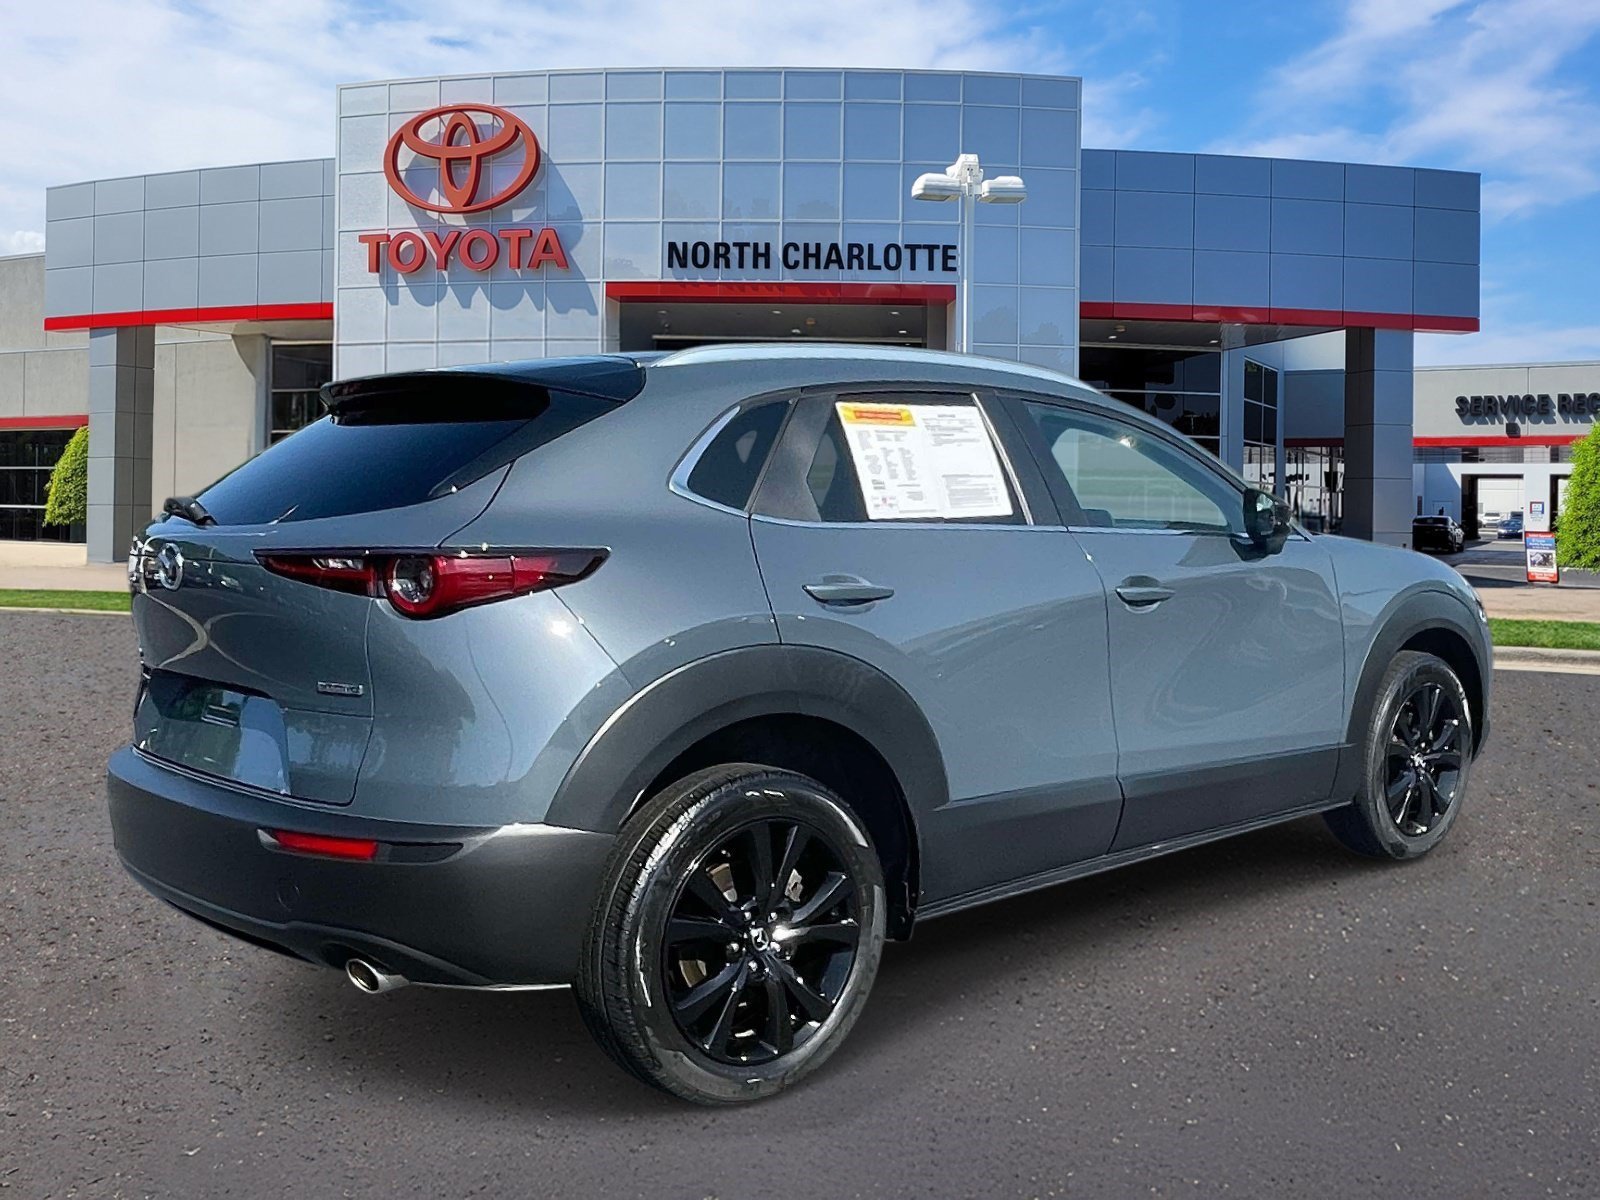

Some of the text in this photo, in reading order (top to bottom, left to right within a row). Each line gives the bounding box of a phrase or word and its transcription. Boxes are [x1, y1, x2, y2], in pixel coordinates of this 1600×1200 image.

[359, 228, 569, 273] TOYOTA
[667, 241, 957, 272] NORTH CHARLOTTE
[1455, 394, 1550, 416] SERVICE
